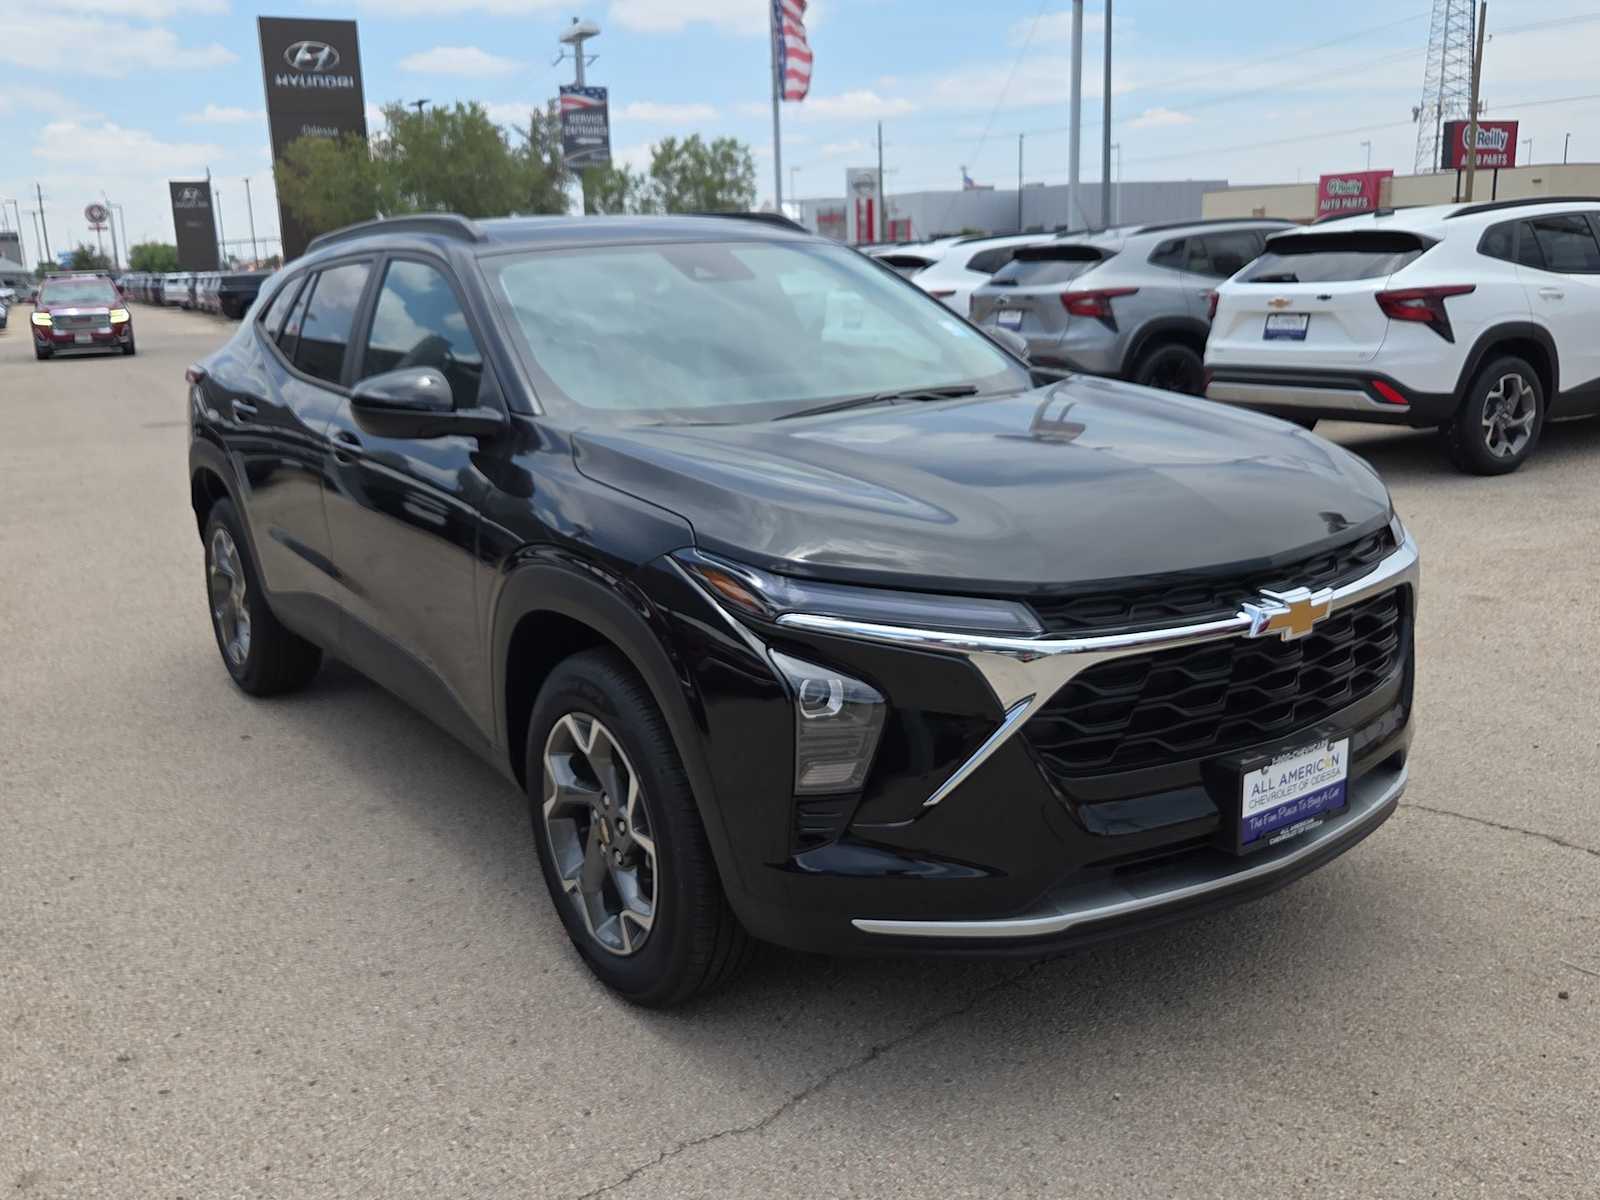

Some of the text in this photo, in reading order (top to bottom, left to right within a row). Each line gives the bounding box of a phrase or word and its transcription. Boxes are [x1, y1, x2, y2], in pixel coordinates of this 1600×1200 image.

[275, 73, 354, 87] HYUNDAI
[1463, 123, 1508, 151] OReilly
[1482, 153, 1508, 166] PARTS
[1320, 196, 1368, 210] AUTO PARTS
[1251, 753, 1340, 797] ALL AMERICAN
[1248, 768, 1341, 809] CHEVROLET OF ODESSA
